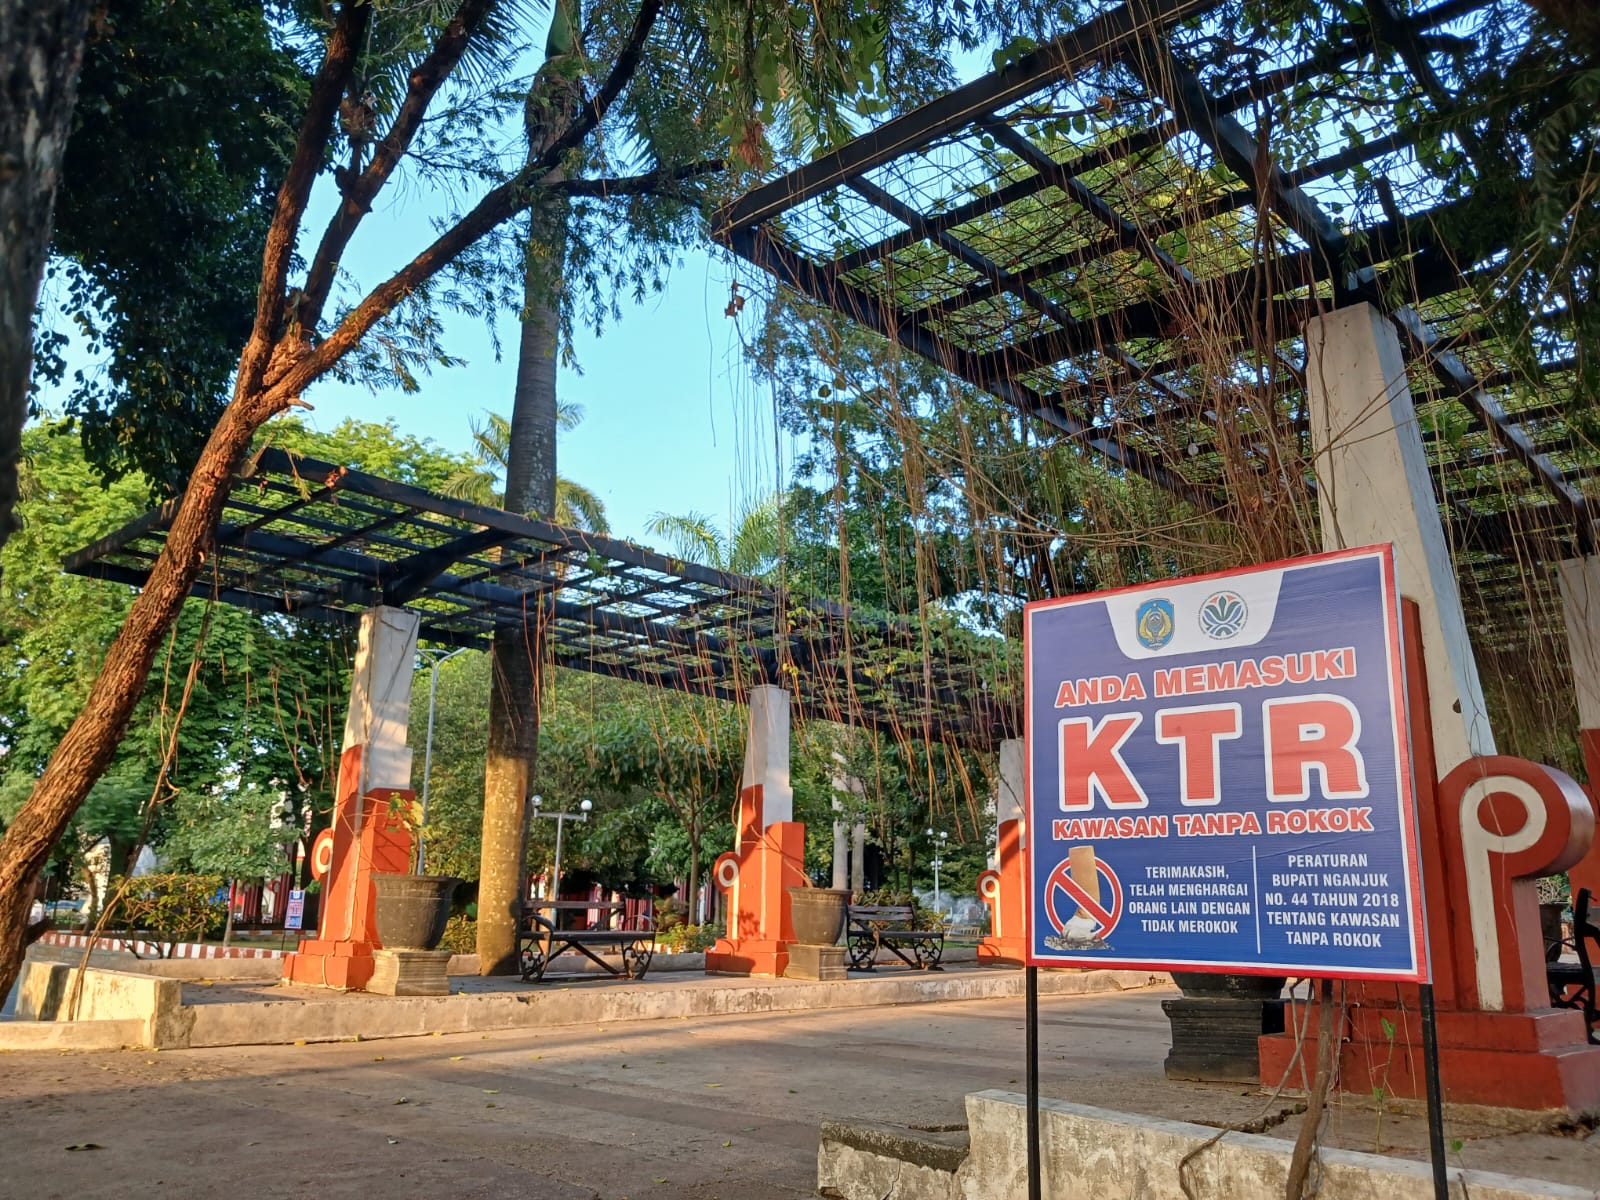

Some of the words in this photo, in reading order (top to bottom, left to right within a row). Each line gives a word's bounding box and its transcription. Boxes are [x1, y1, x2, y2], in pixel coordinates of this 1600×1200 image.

[1054, 673, 1146, 708] ANDA
[1154, 647, 1357, 698] MEMASUKI
[1057, 694, 1369, 812] KTR
[1052, 816, 1168, 840] KAWASAN
[1174, 812, 1261, 836] TANPA
[1266, 807, 1374, 834] ROKOK
[1288, 853, 1368, 868] PERATURAN
[1145, 866, 1229, 879] TERIMAKASIH,
[1272, 874, 1318, 887] BUPATI
[1323, 874, 1388, 888] NGANJUK
[1130, 884, 1165, 896] TELAH
[1168, 884, 1248, 896] MENGHARGAI
[1265, 893, 1287, 906] NO.
[1291, 893, 1308, 906] 44
[1312, 893, 1358, 907] TAHUN
[1363, 893, 1399, 907] 2018
[1129, 902, 1168, 914] ORANG
[1172, 902, 1197, 914] LAIN
[1201, 902, 1250, 915] DENGAN
[1141, 919, 1175, 932] TIDAK
[1179, 920, 1238, 934] MEROKOK
[1267, 911, 1327, 926] TENTANG
[1331, 912, 1400, 927] KAWASAN
[1286, 932, 1329, 945] TANPA
[1333, 933, 1381, 948] ROKOK
